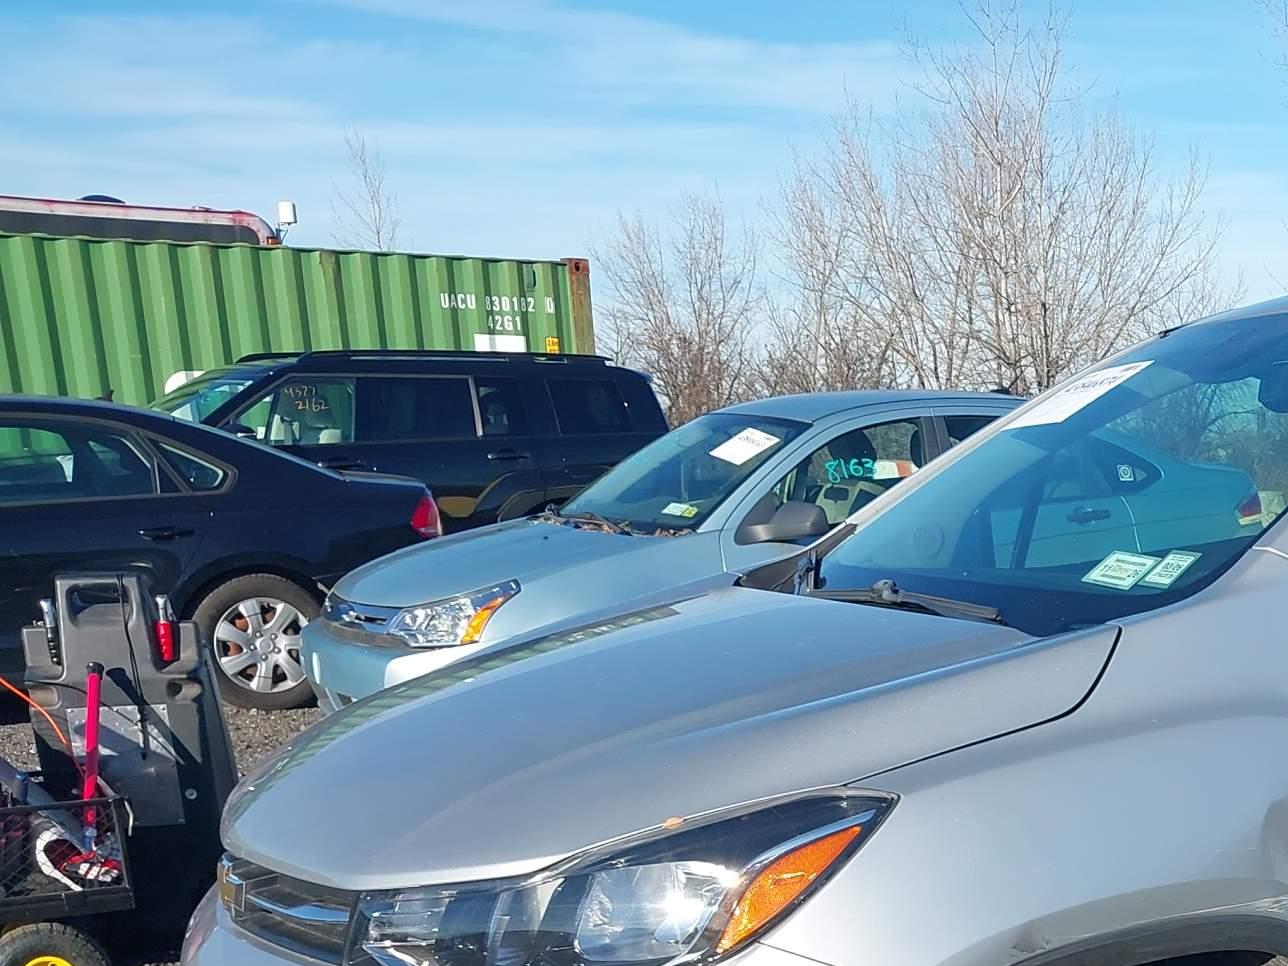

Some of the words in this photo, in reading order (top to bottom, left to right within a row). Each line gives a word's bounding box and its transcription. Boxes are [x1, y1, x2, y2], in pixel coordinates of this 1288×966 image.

[440, 293, 476, 309] UACU
[485, 296, 535, 312] 830182
[488, 315, 521, 331] 42G1
[295, 398, 329, 412] 2162
[825, 458, 876, 483] 8163
